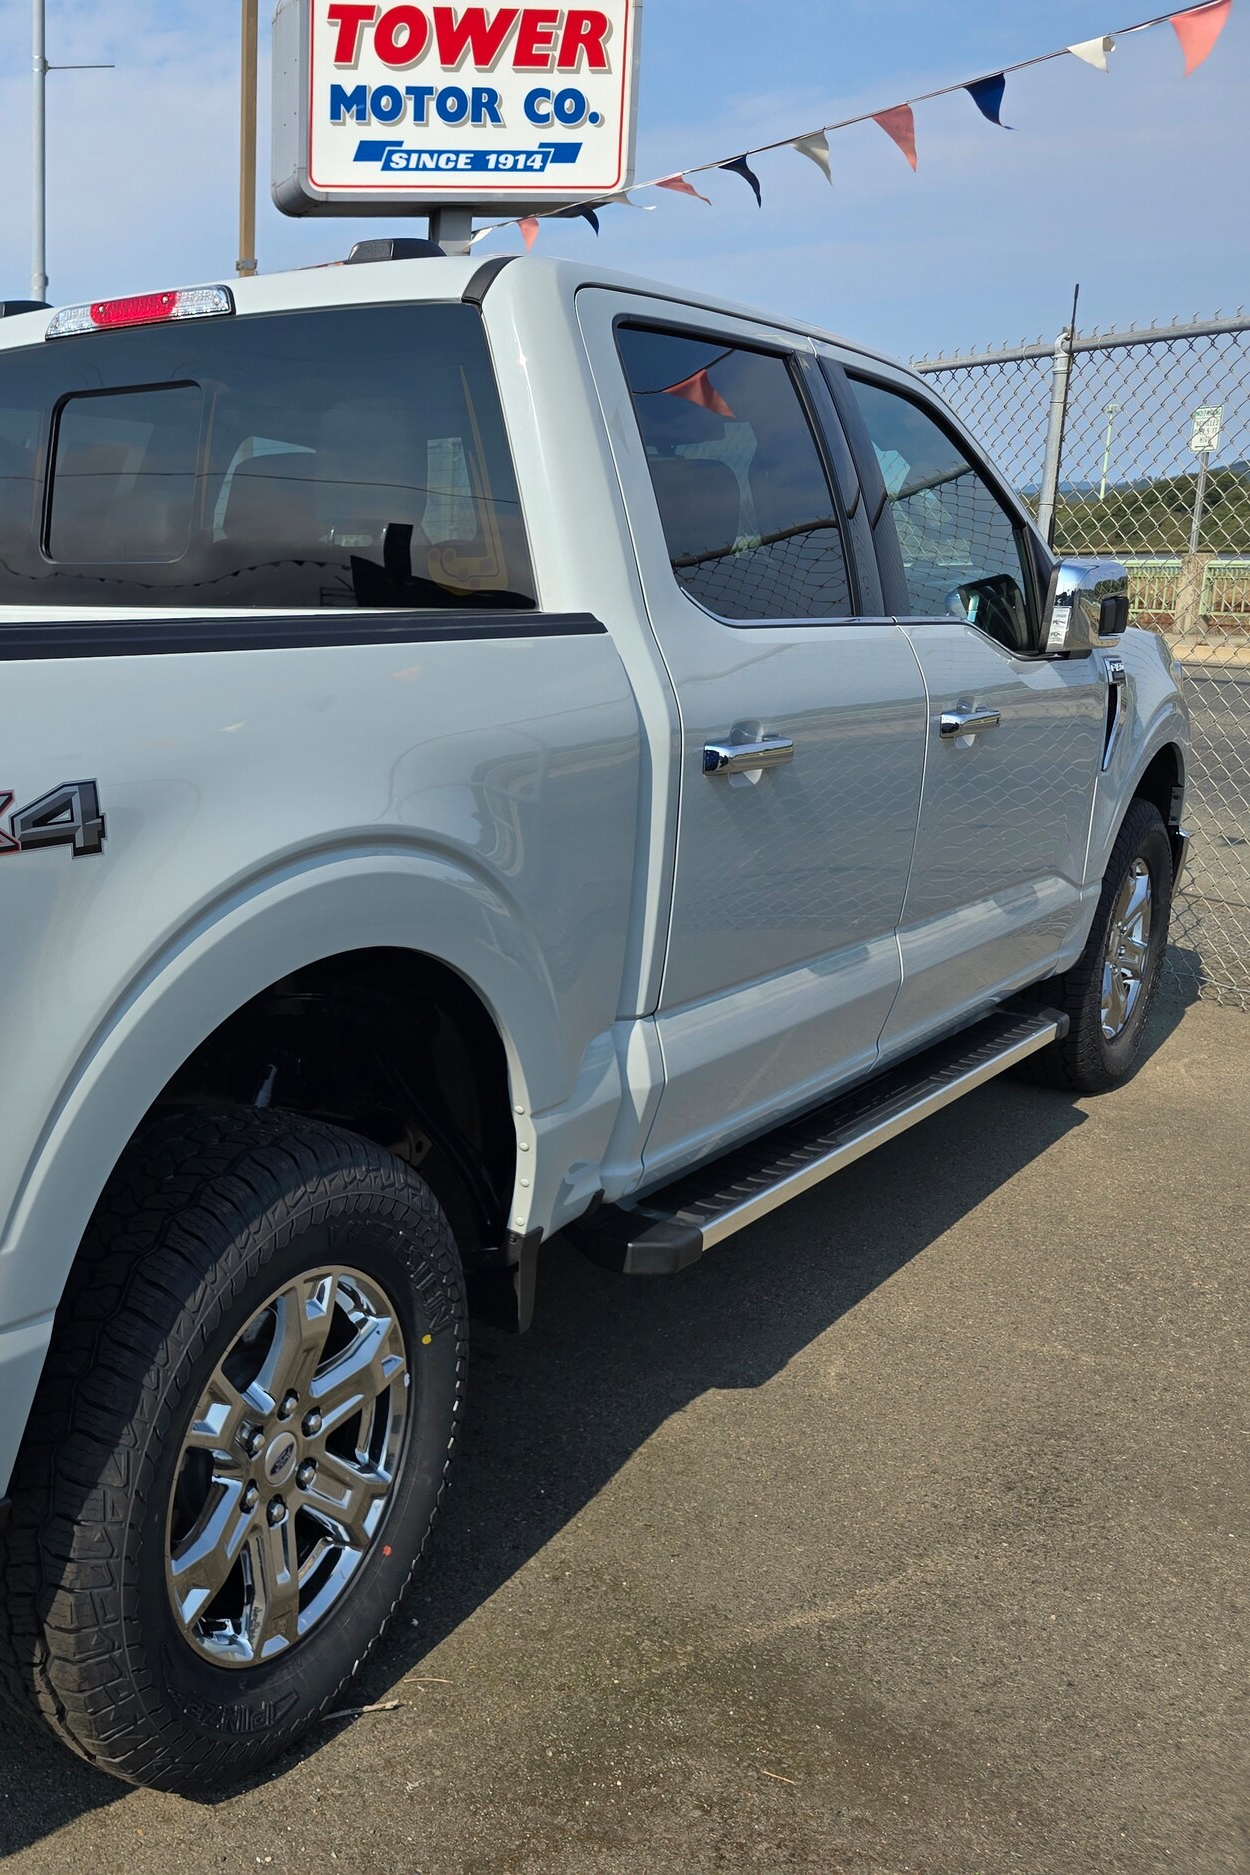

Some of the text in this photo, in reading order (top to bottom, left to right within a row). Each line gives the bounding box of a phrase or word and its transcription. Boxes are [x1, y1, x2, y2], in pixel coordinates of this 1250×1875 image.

[327, 4, 610, 72] TOWER
[329, 84, 602, 127] MOTOR CO.
[389, 152, 544, 170] SINCE 1914
